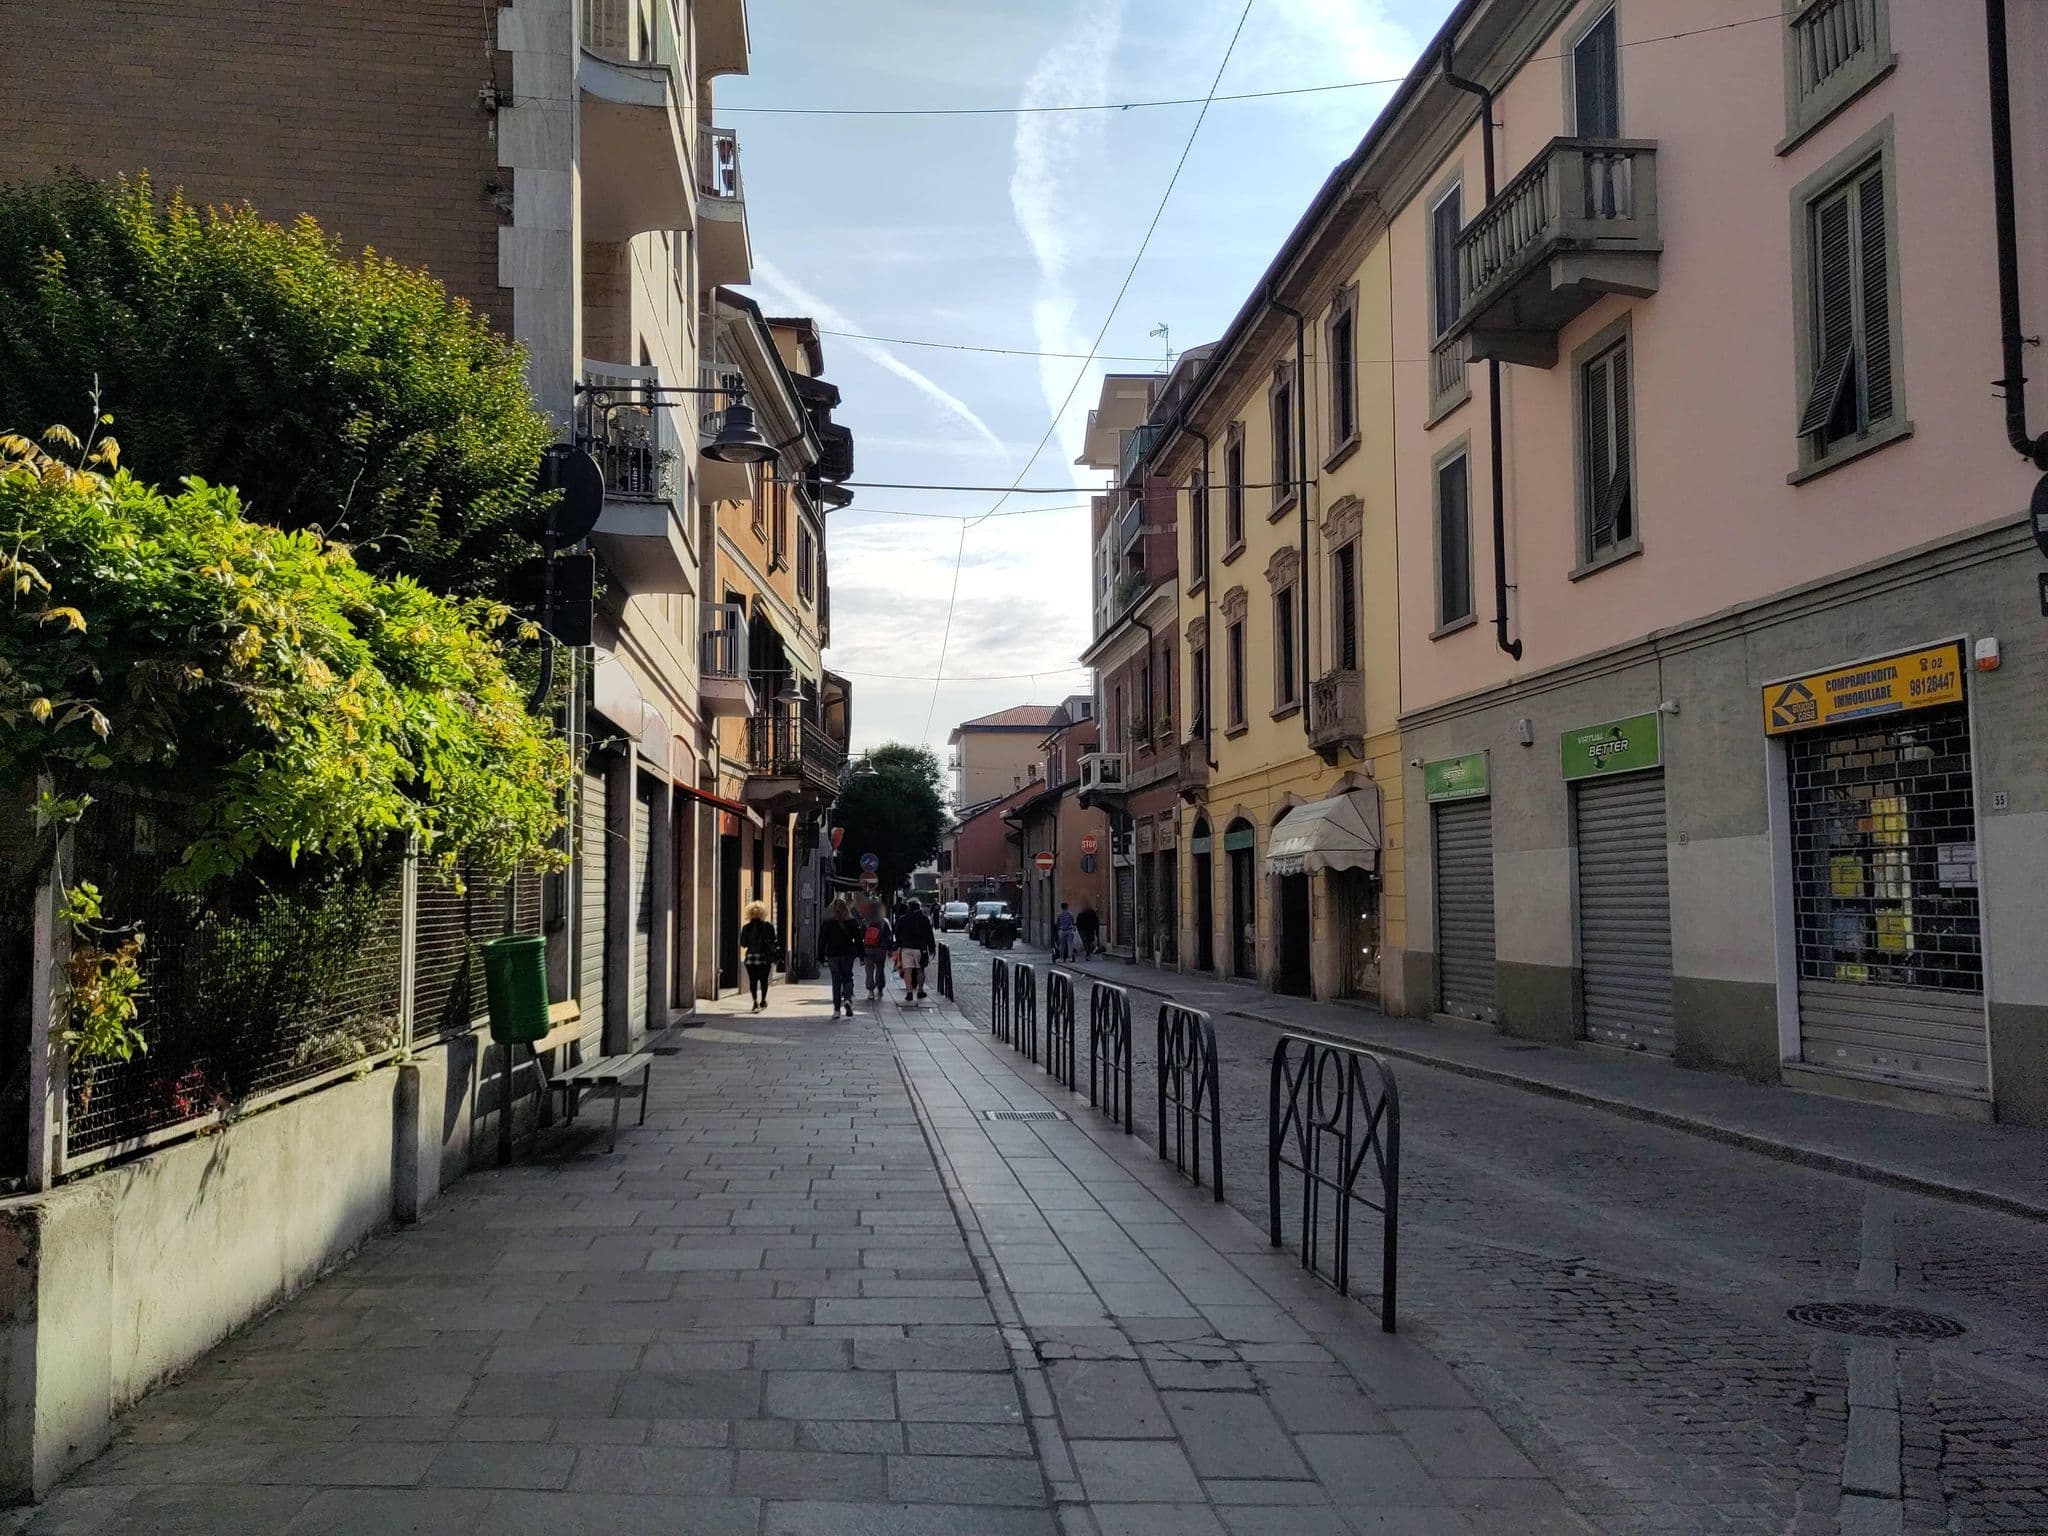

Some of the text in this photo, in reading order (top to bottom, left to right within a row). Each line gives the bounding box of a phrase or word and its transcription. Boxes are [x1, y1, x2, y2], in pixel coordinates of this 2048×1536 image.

[1931, 657, 1943, 669] 02
[1825, 665, 1898, 693] COMPRAVENDITA
[1909, 671, 1955, 696] 98128447
[1833, 684, 1893, 709] IMMOBILIARE
[1577, 732, 1604, 745] VIRTUAL
[1588, 739, 1629, 758] BETTER
[1443, 769, 1466, 780] BETTER
[1995, 795, 2005, 806] 55
[1082, 839, 1096, 849] STOP
